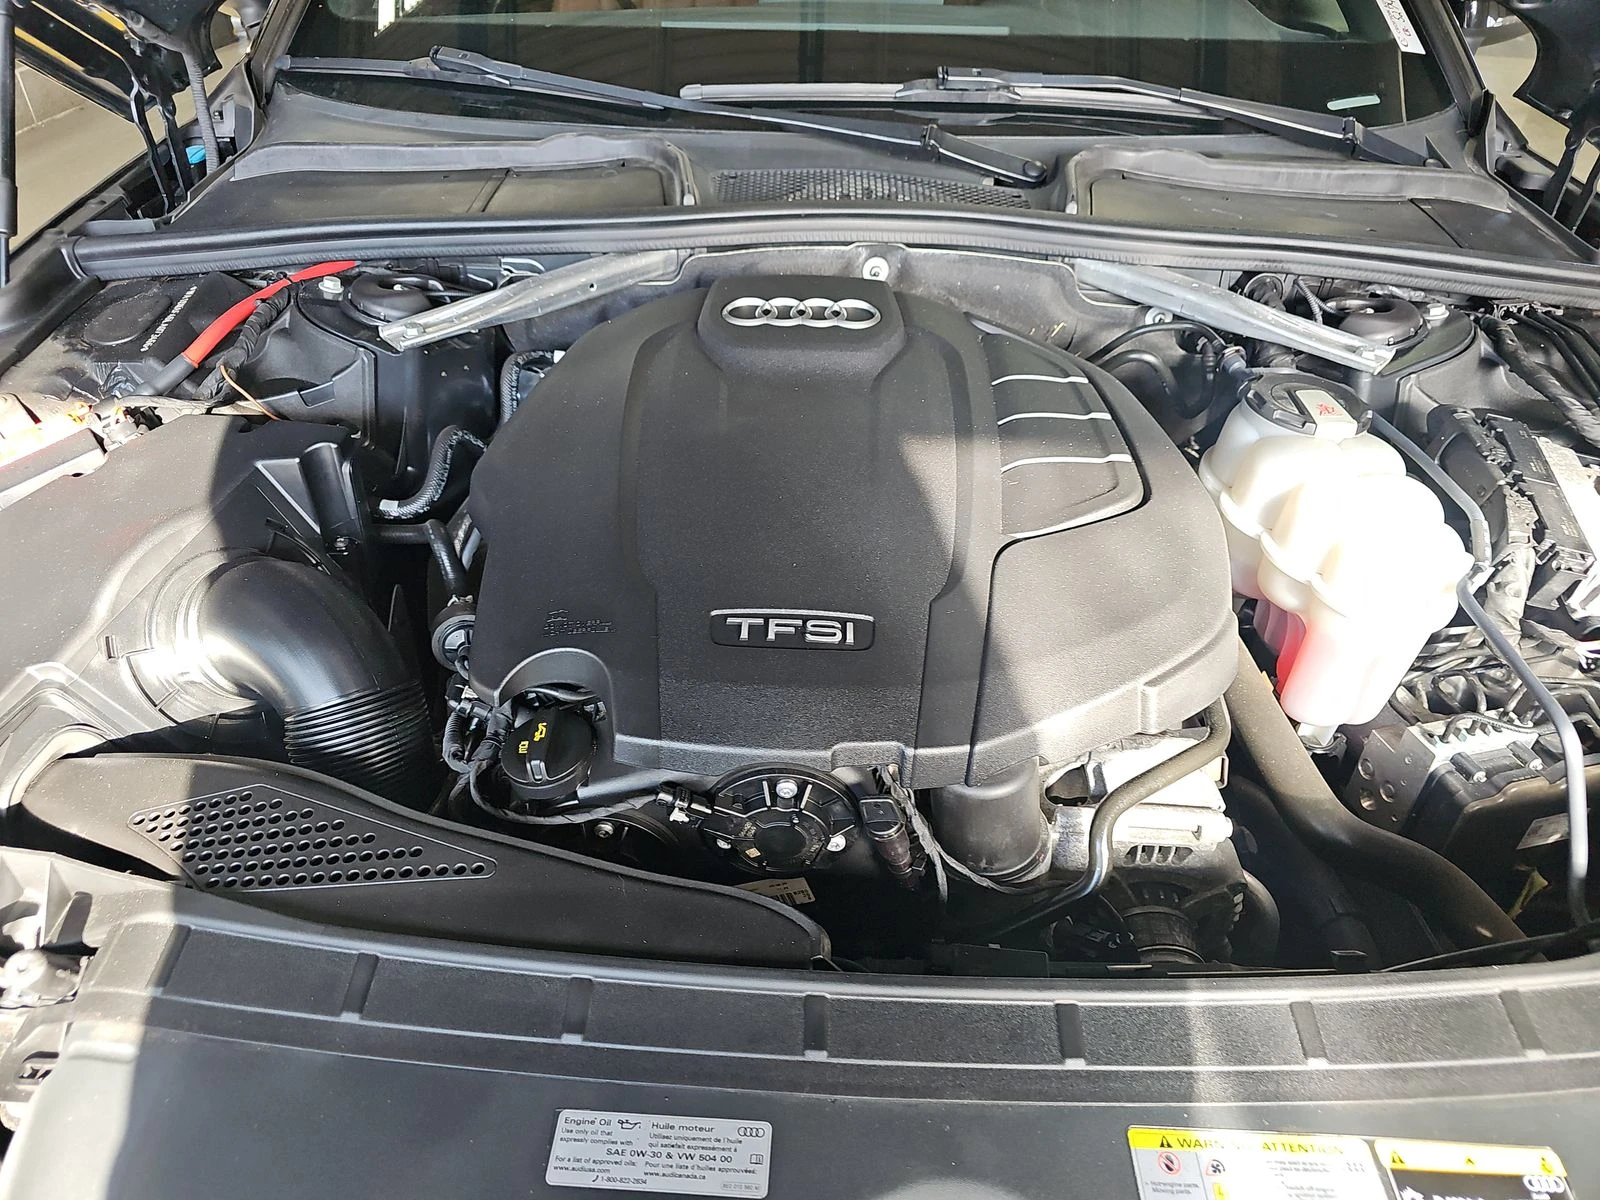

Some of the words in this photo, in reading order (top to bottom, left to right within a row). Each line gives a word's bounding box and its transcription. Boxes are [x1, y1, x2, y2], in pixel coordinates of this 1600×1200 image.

[726, 617, 854, 645] TFSI
[564, 1117, 596, 1127] Engine
[599, 1118, 612, 1127] Oil
[575, 1128, 589, 1136] only
[651, 1122, 676, 1131] Huile
[678, 1124, 716, 1133] moteur
[555, 1155, 566, 1163] For
[605, 1147, 627, 1157] SAE
[629, 1149, 663, 1160] 0W-30
[665, 1151, 674, 1160] &
[677, 1152, 696, 1161] VW
[698, 1153, 717, 1162] 504
[719, 1155, 733, 1164] 00
[644, 1160, 660, 1169] Pour
